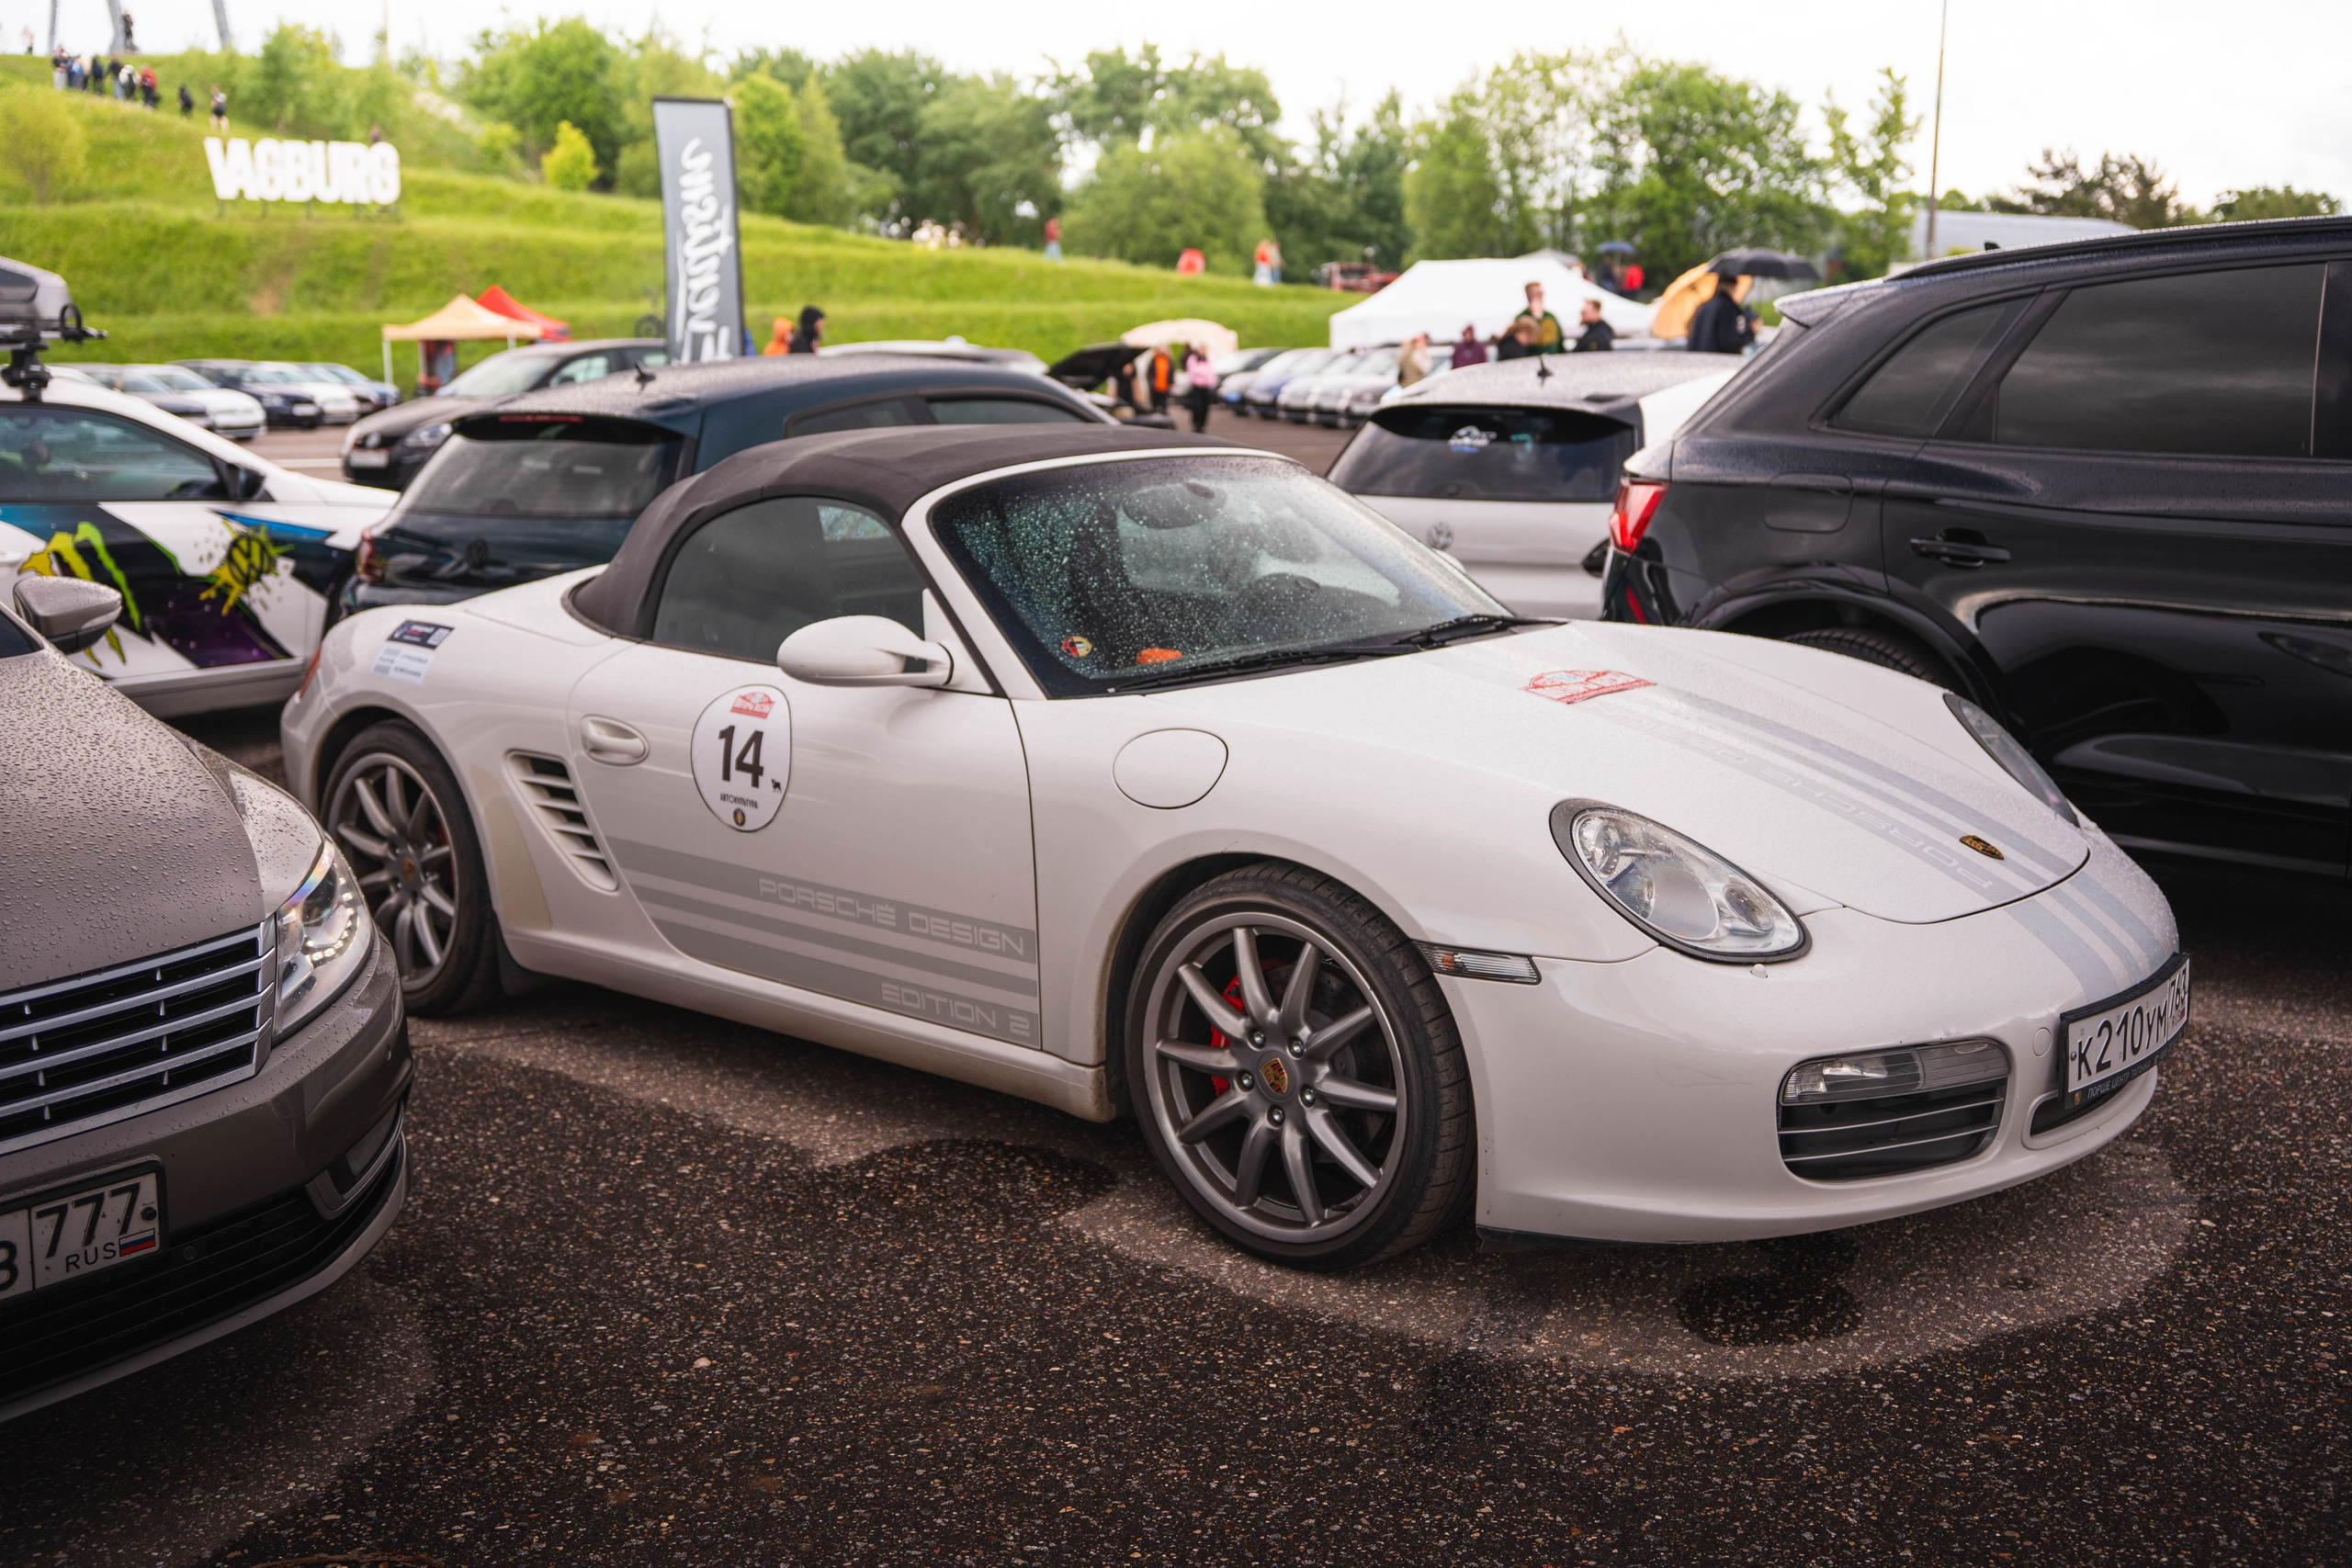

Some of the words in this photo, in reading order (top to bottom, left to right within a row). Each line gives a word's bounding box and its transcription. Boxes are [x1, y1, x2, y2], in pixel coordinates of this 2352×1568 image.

[203, 137, 401, 205] VAGBURG
[718, 725, 763, 788] 14
[1758, 767, 1994, 890] PORSCHE
[758, 878, 897, 927] PORSCHE
[908, 911, 1024, 956] DESIGN
[880, 981, 997, 1030] EDITION
[1009, 1013, 1031, 1038] 2
[2087, 1079, 2111, 1099] ПОРШЕ
[2111, 1072, 2131, 1090] ЦЕНТР
[36, 1181, 141, 1258] 777
[65, 1242, 117, 1272] RUS
